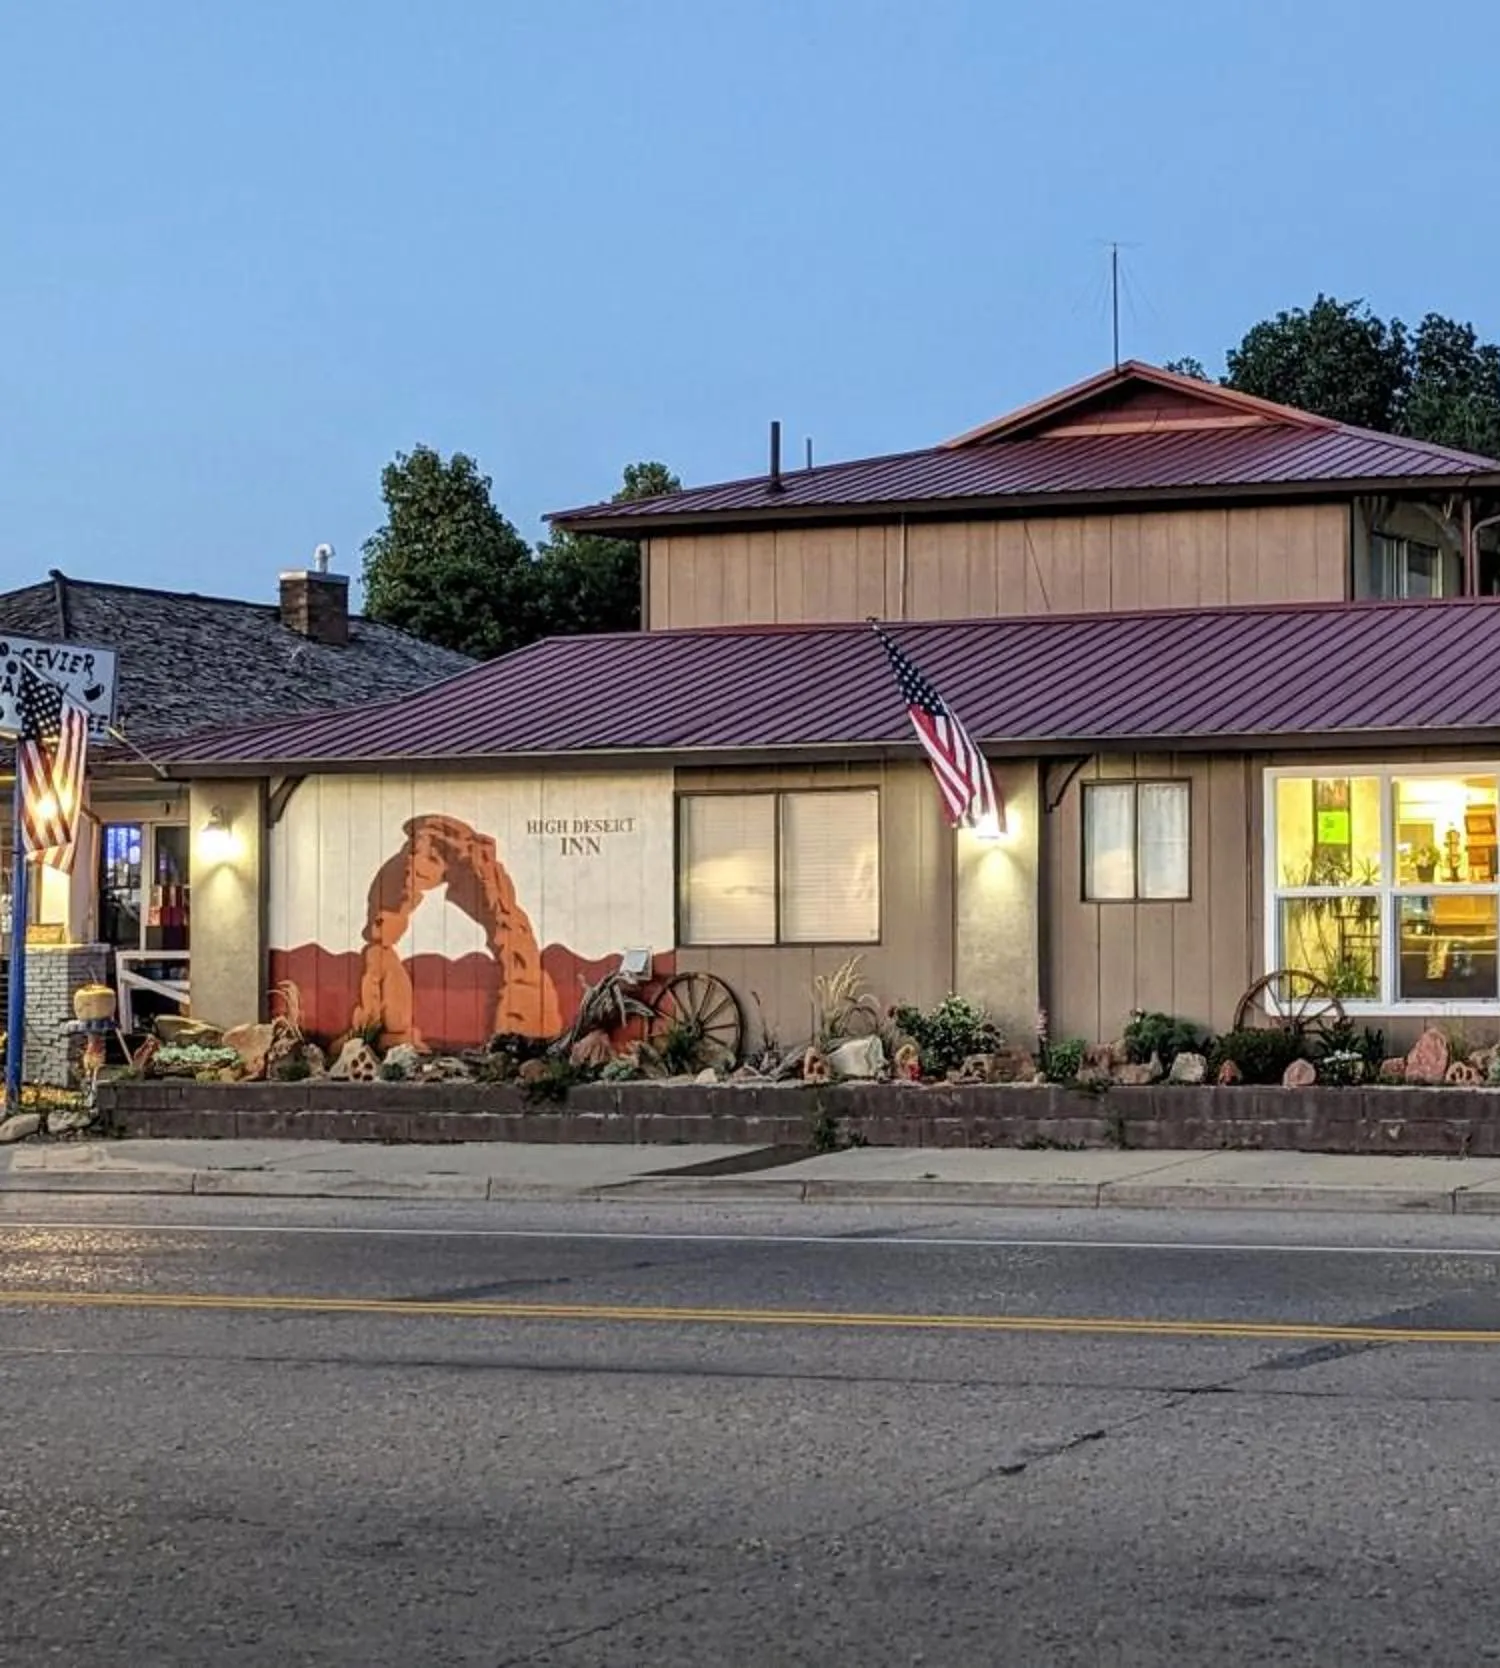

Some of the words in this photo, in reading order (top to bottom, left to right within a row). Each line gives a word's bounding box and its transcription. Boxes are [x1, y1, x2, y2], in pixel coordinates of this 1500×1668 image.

[527, 819, 567, 834] HIGH
[573, 818, 635, 833] DESERT
[560, 836, 601, 856] INN
